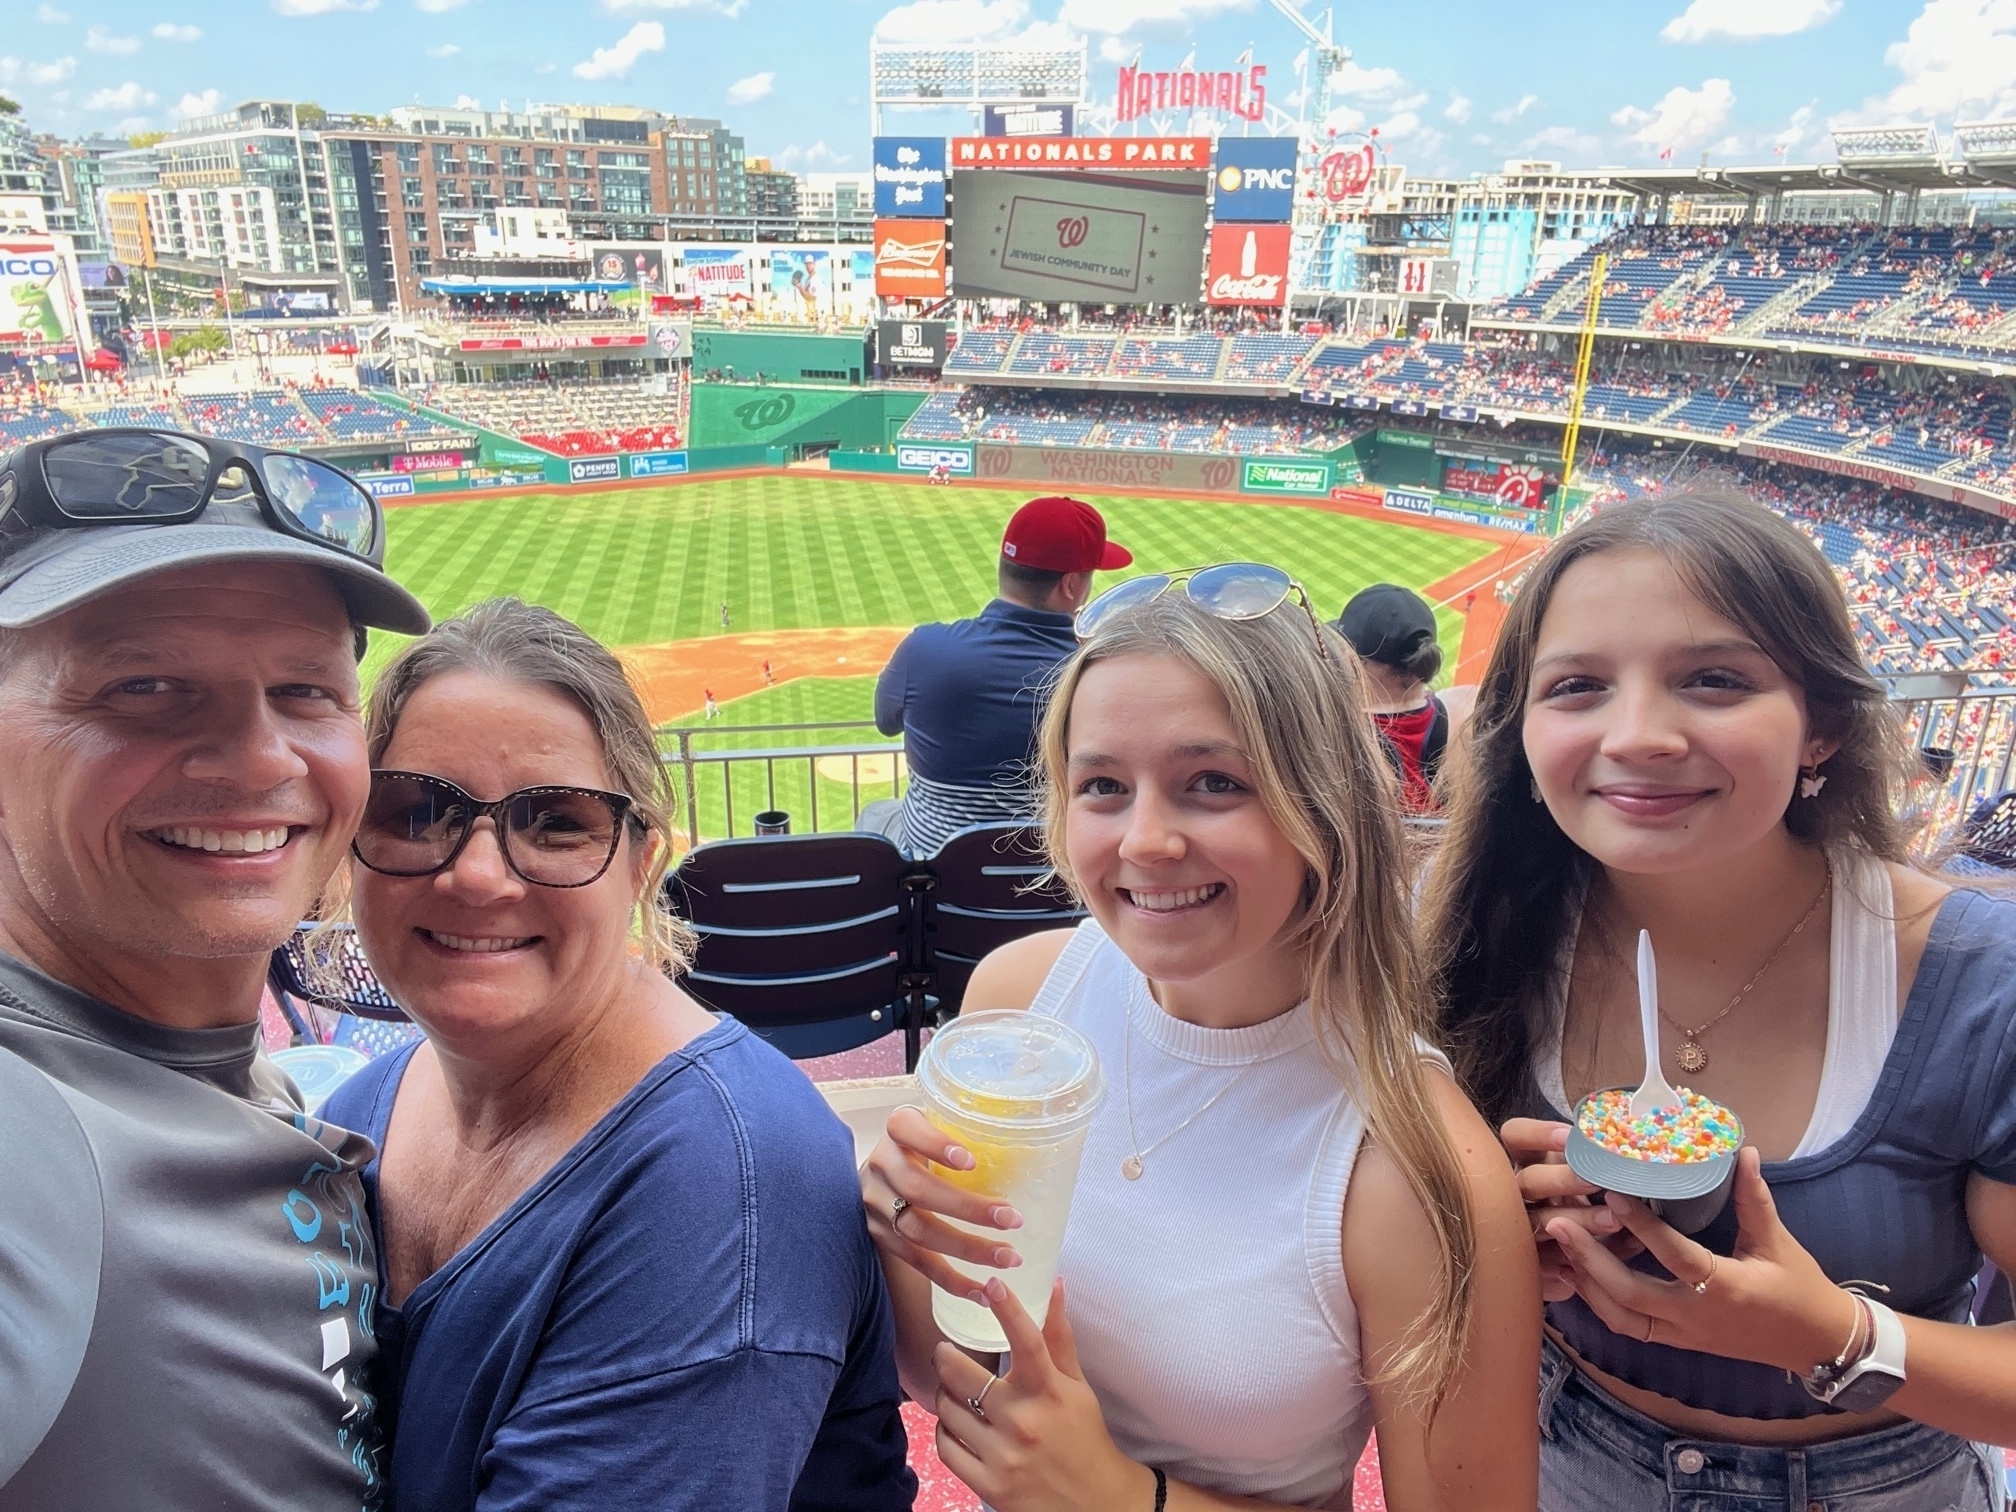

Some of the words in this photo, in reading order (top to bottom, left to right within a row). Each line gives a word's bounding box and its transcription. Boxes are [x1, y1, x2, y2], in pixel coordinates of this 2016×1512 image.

[1117, 65, 1267, 122] NATIONALS
[960, 143, 1113, 162] NATIONALS
[1125, 143, 1195, 162] PARK
[1243, 168, 1294, 190] PNC
[1009, 250, 1046, 264] JEWISH
[1047, 255, 1109, 274] COMMUNITY
[1109, 266, 1132, 278] DAY
[698, 264, 746, 282] NATITUDE
[890, 345, 934, 357] BETMGM
[443, 438, 471, 450] FAN
[415, 454, 454, 470] Mobile
[901, 450, 969, 467] GEICO
[1040, 450, 1174, 472] WASHINGTON
[586, 463, 617, 473] PENFED
[1051, 465, 1161, 486] NATIONALS
[1755, 445, 1842, 473] WASHINGTON
[1844, 463, 1917, 490] NATIONALS
[373, 481, 410, 495] Terra
[1397, 495, 1430, 511] DELTA
[1489, 516, 1526, 532] RE/MAX
